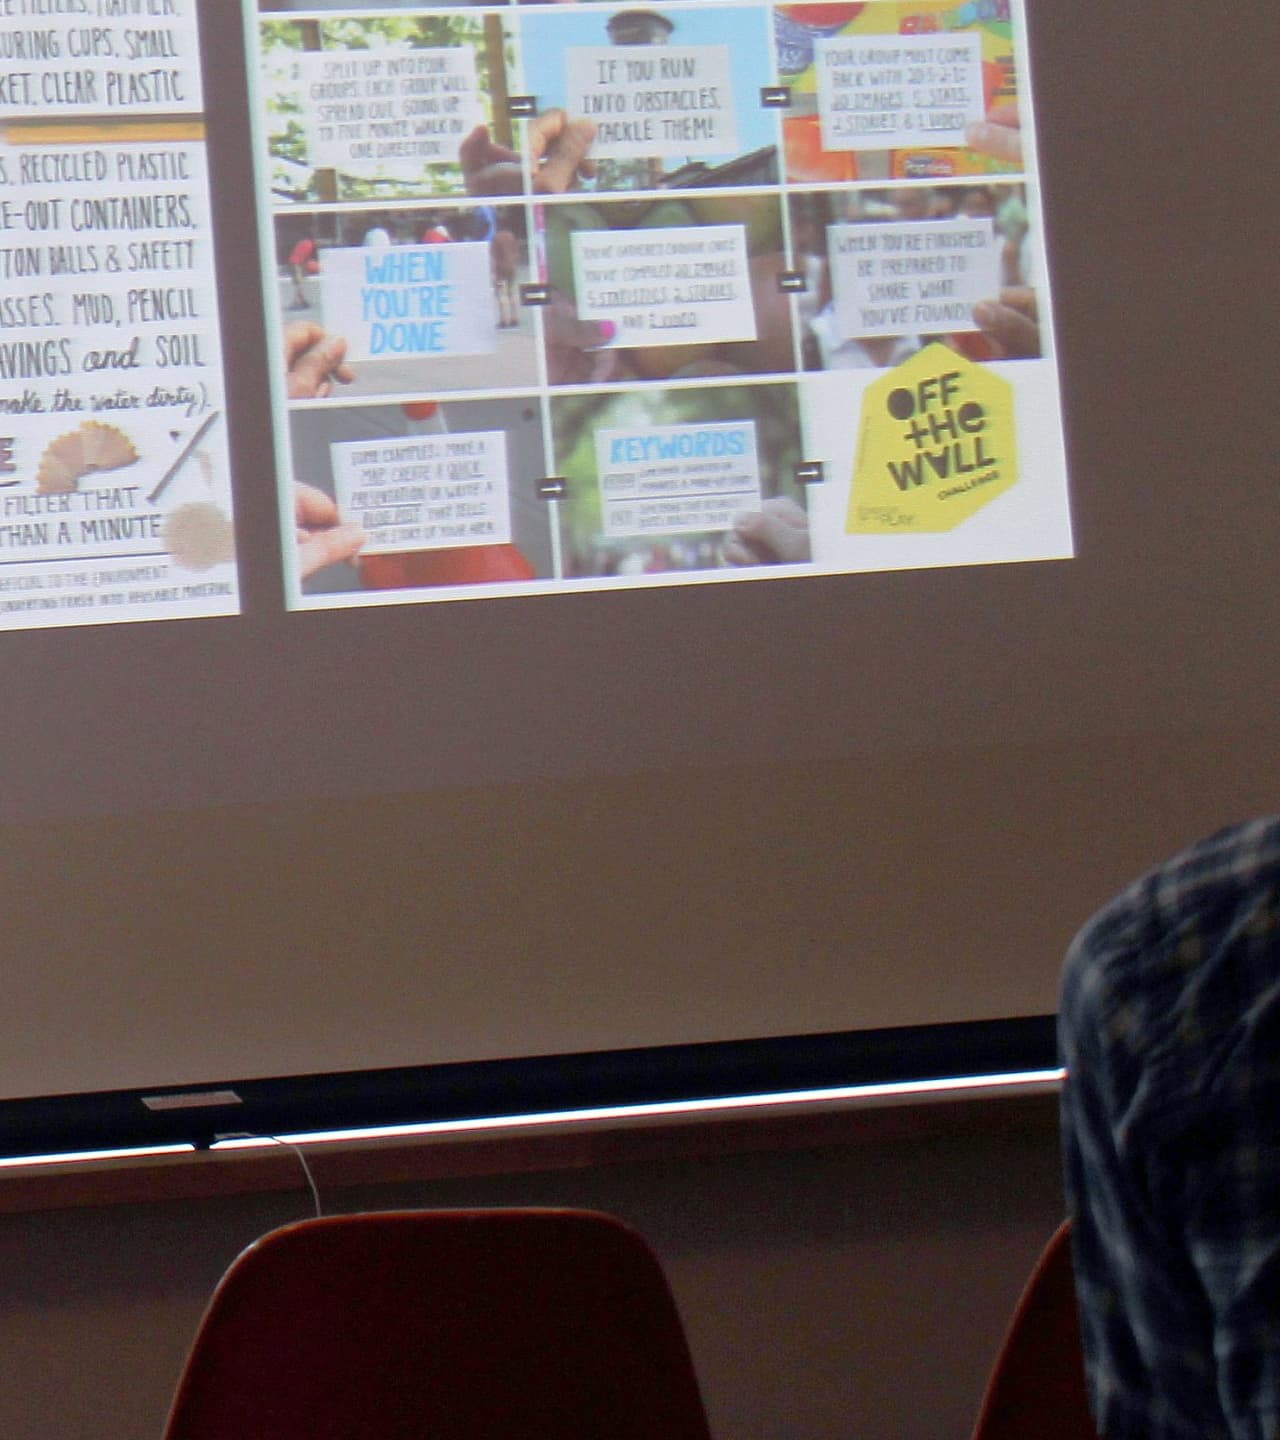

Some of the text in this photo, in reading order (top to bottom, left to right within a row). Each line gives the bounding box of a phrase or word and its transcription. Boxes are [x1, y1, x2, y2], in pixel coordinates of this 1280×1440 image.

[123, 29, 179, 60] SMALL
[42, 70, 185, 105] CLEAR PLASTIC
[661, 117, 714, 141] THEM!
[20, 150, 189, 185] RECYCLED PLASTIC
[128, 239, 194, 271] SAFETY
[365, 251, 444, 284] WHEN
[128, 288, 198, 323] PENCIL
[360, 285, 453, 322] YOU'RE
[82, 336, 140, 372] and
[155, 333, 208, 368] SOIL
[370, 321, 448, 354] DONE
[887, 371, 961, 421] OFF
[610, 431, 747, 465] KEYWORDS
[887, 436, 996, 492] WALL
[79, 486, 139, 511] THAT
[80, 513, 162, 543] MINUTE
